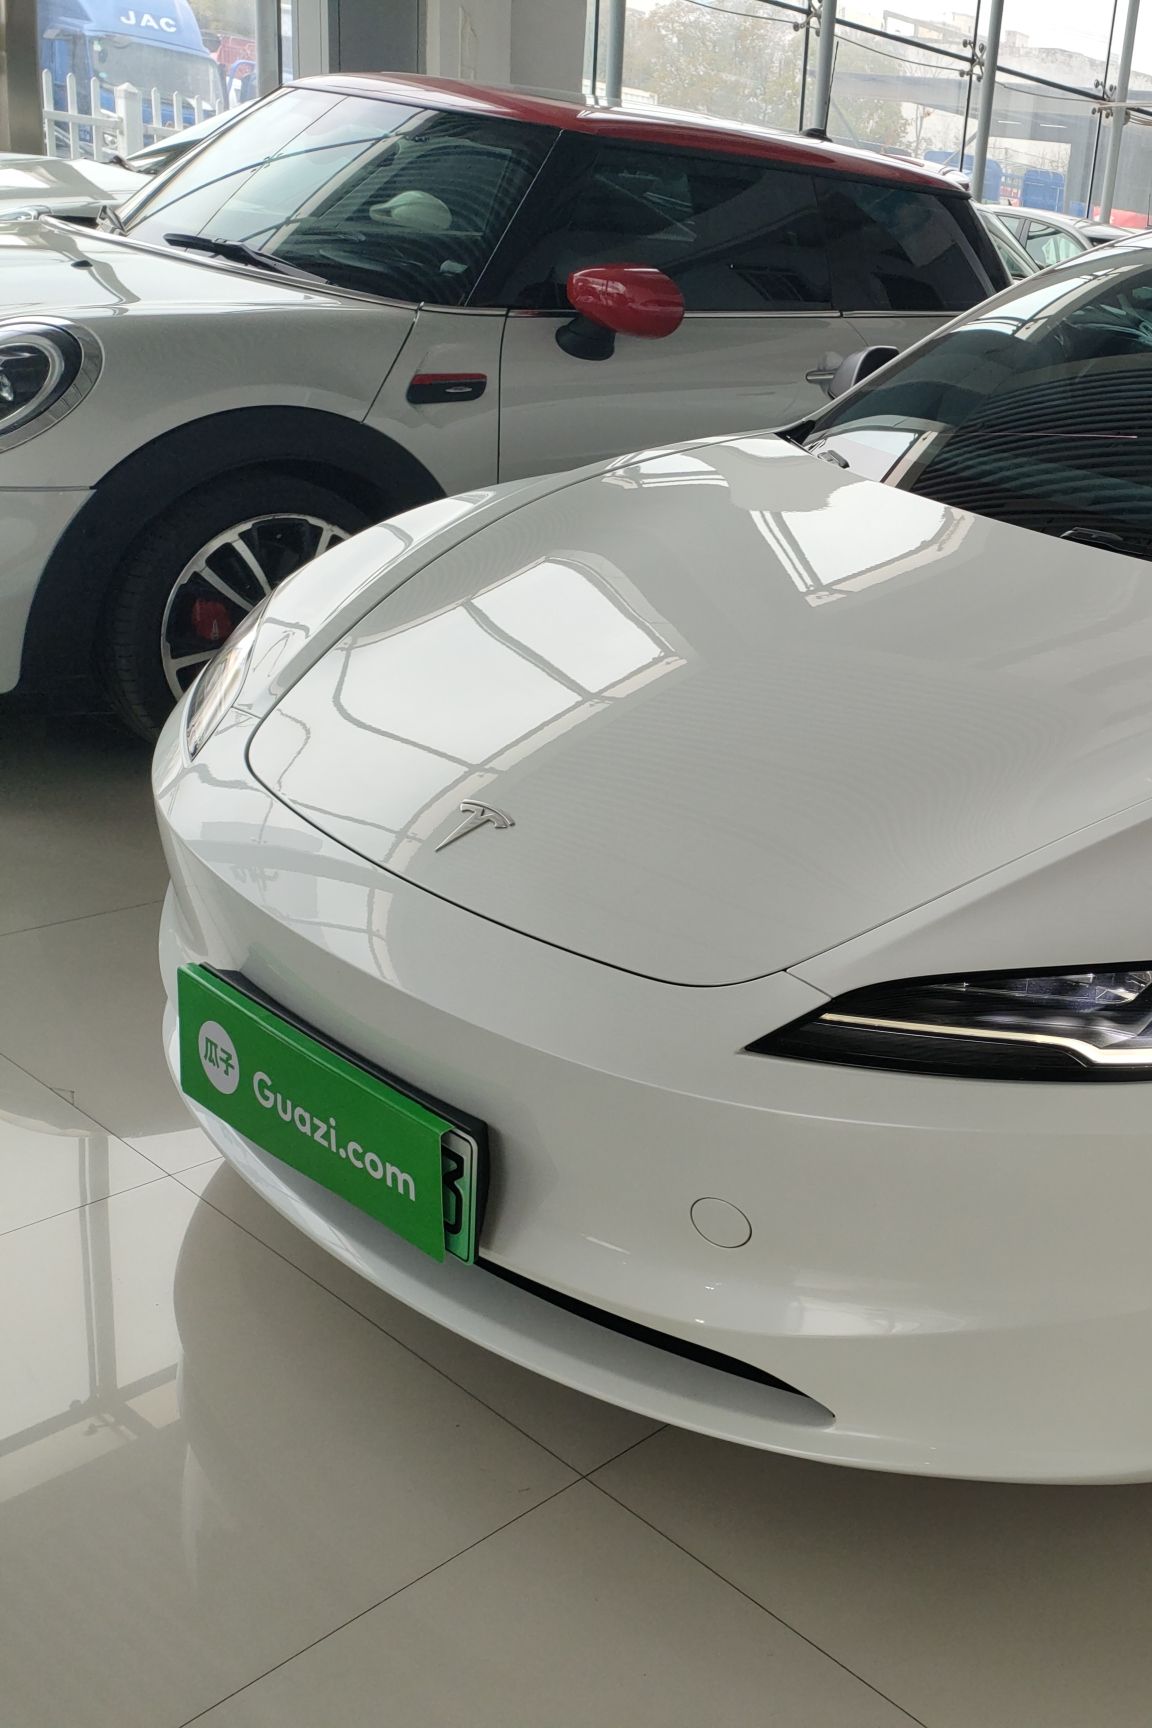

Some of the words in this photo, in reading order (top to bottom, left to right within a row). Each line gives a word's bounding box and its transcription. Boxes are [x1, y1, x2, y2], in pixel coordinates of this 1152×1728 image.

[120, 10, 177, 33] JAC
[204, 1036, 235, 1077] 瓜子
[252, 1071, 416, 1202] Guazi.com
